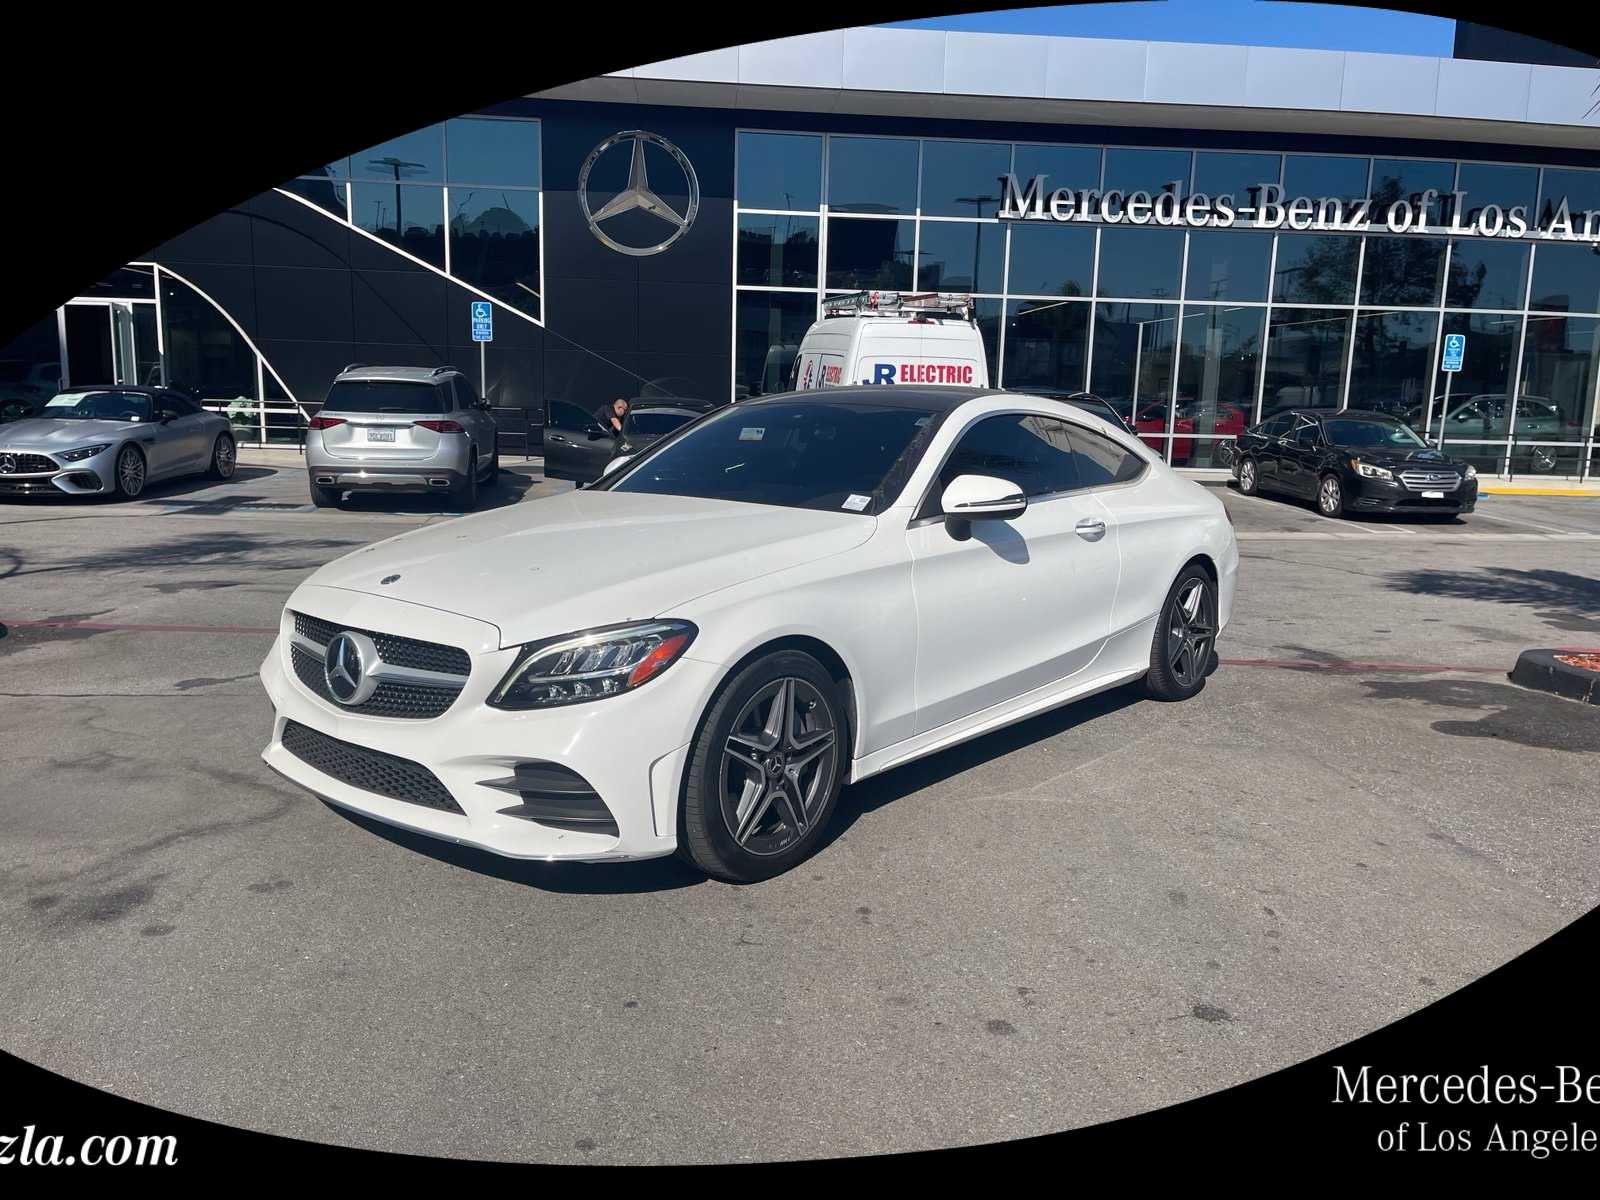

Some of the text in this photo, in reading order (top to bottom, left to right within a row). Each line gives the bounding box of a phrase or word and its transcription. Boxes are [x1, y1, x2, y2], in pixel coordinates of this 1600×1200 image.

[998, 172, 1600, 242] Mercedes-Benz of Los An
[901, 364, 973, 384] ELECTRIC
